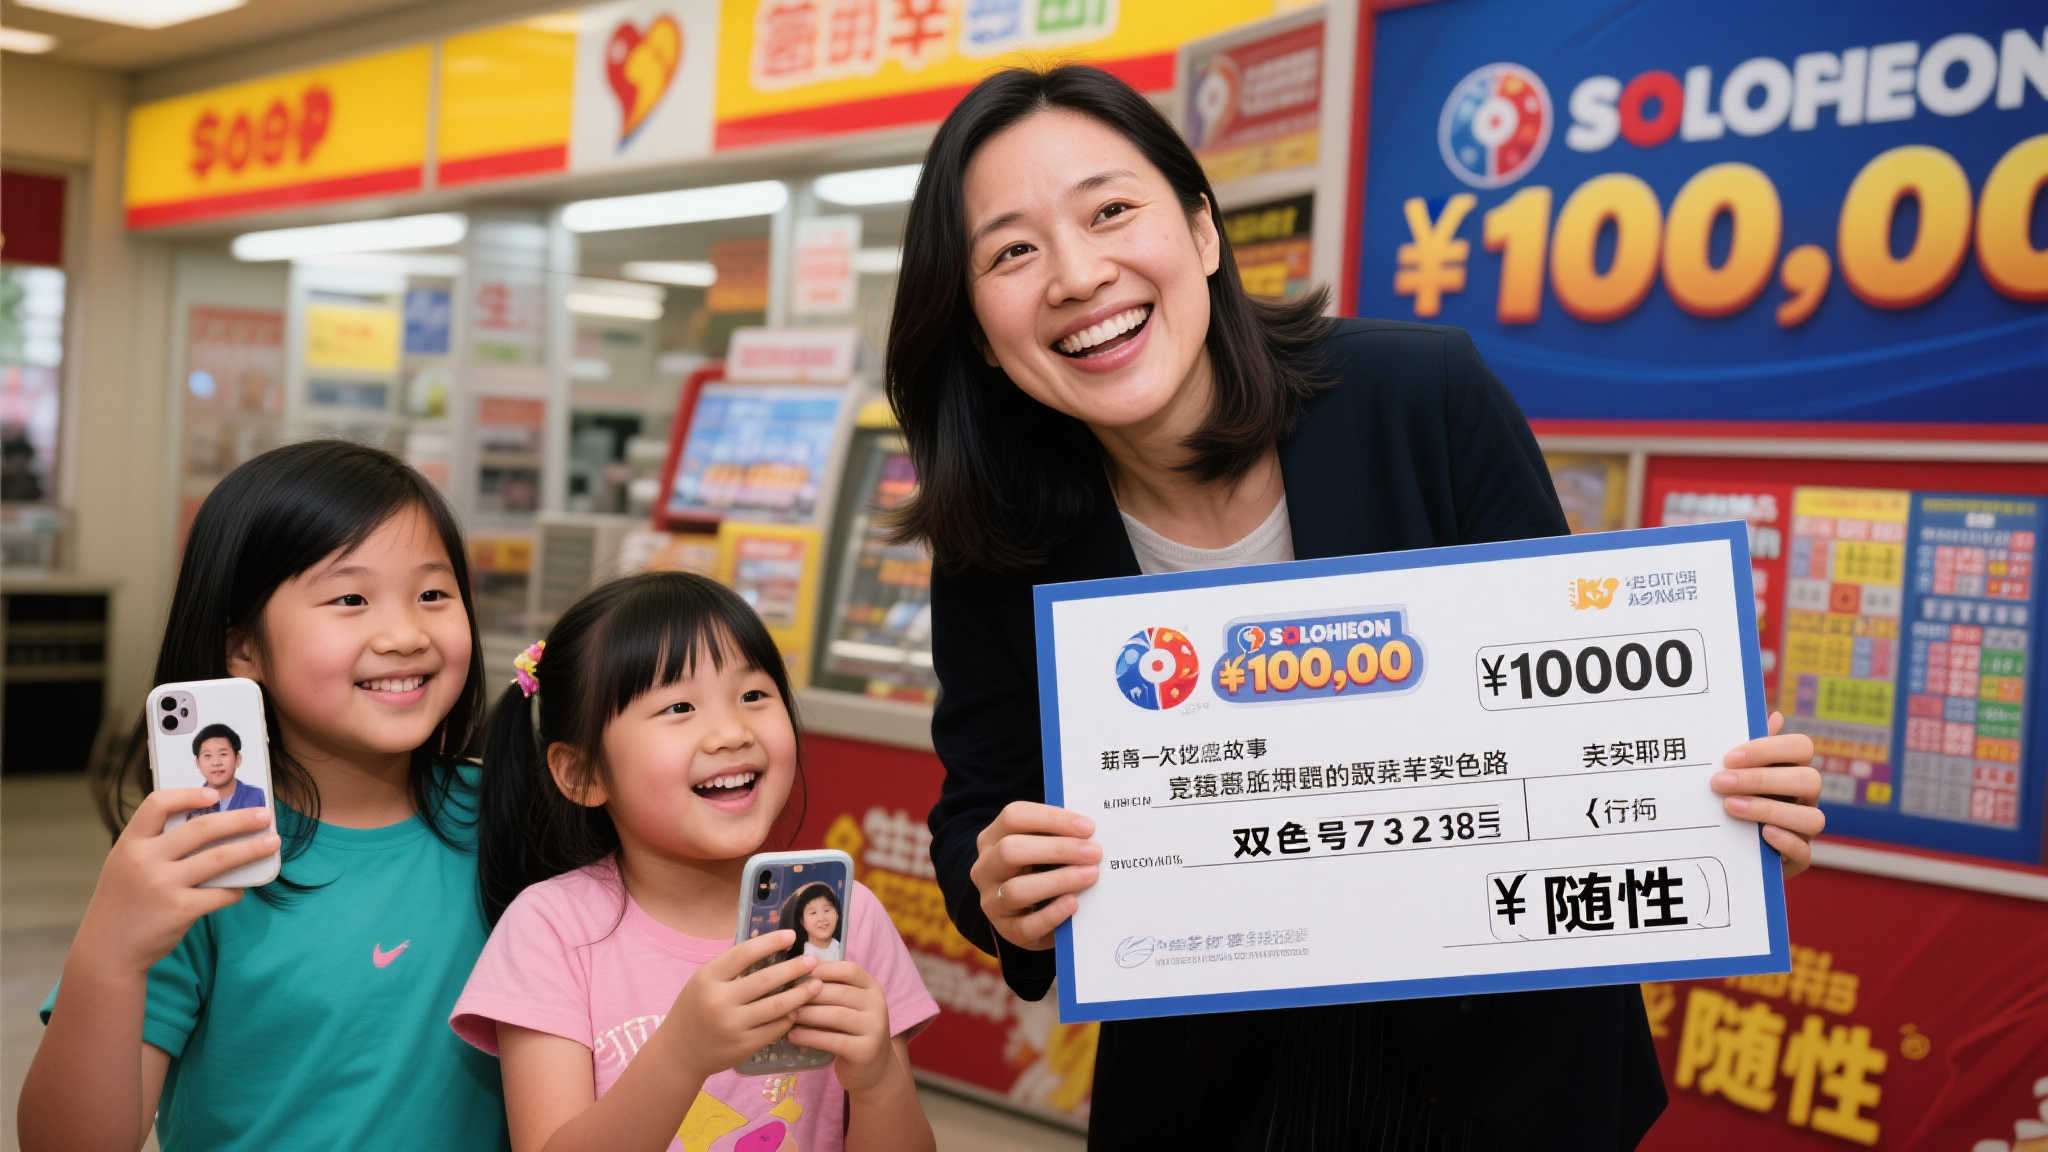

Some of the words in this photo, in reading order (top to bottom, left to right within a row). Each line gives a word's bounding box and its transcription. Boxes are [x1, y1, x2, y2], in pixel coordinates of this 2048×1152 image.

[1218, 640, 1413, 694] ¥100,00
[1481, 638, 1693, 699] ¥10000
[1544, 866, 1689, 935] 随性
[1674, 985, 1888, 1147] 随性
